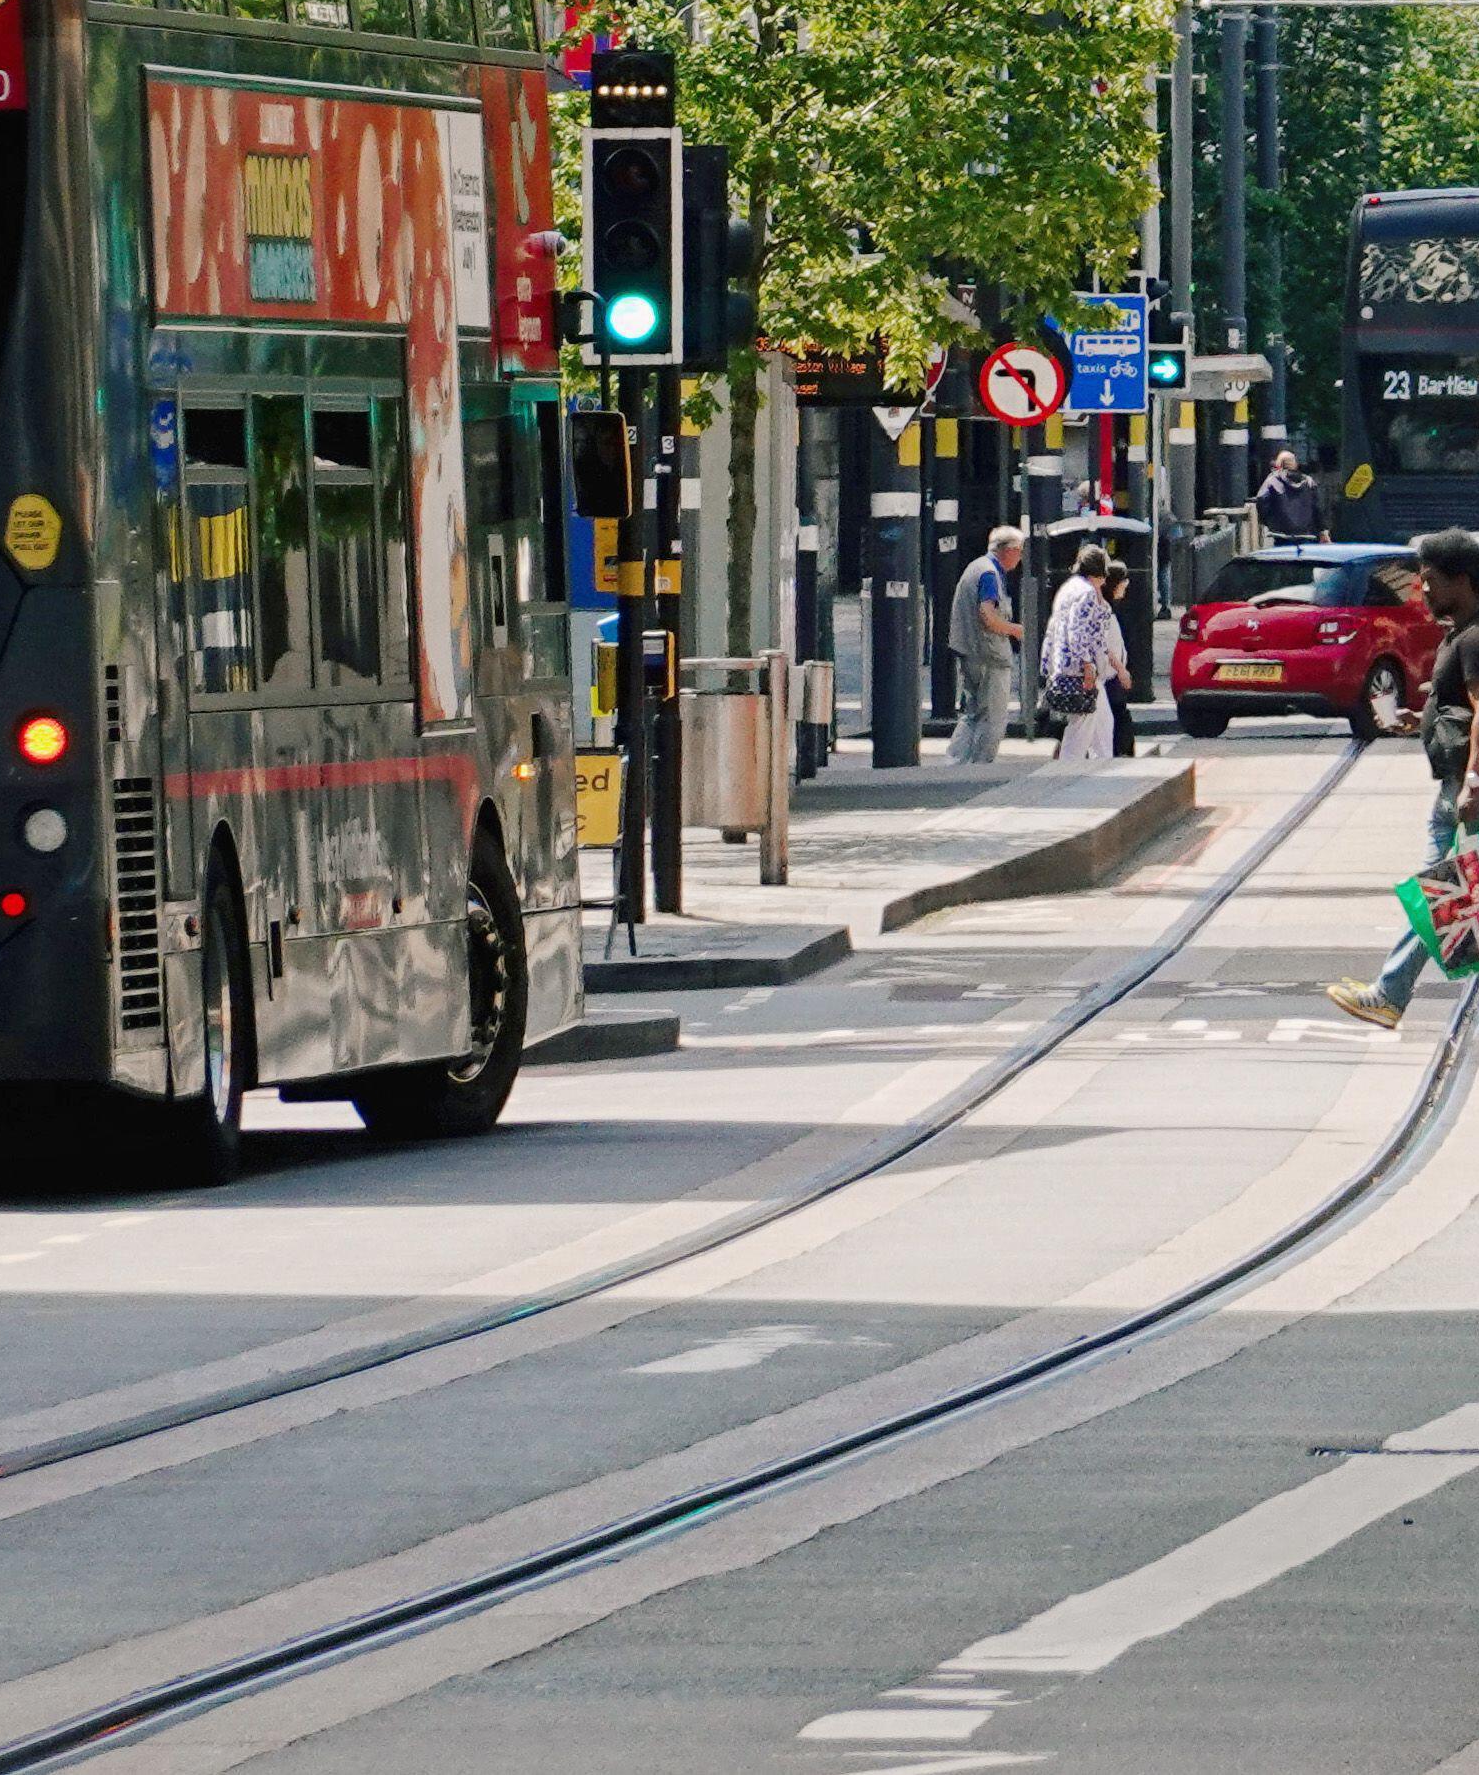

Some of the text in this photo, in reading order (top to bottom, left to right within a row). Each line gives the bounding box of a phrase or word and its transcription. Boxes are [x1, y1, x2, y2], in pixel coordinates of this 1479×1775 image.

[1077, 362, 1107, 374] taxis
[1383, 370, 1411, 401] 23
[1418, 373, 1478, 396] Bartley
[663, 437, 674, 451] 3
